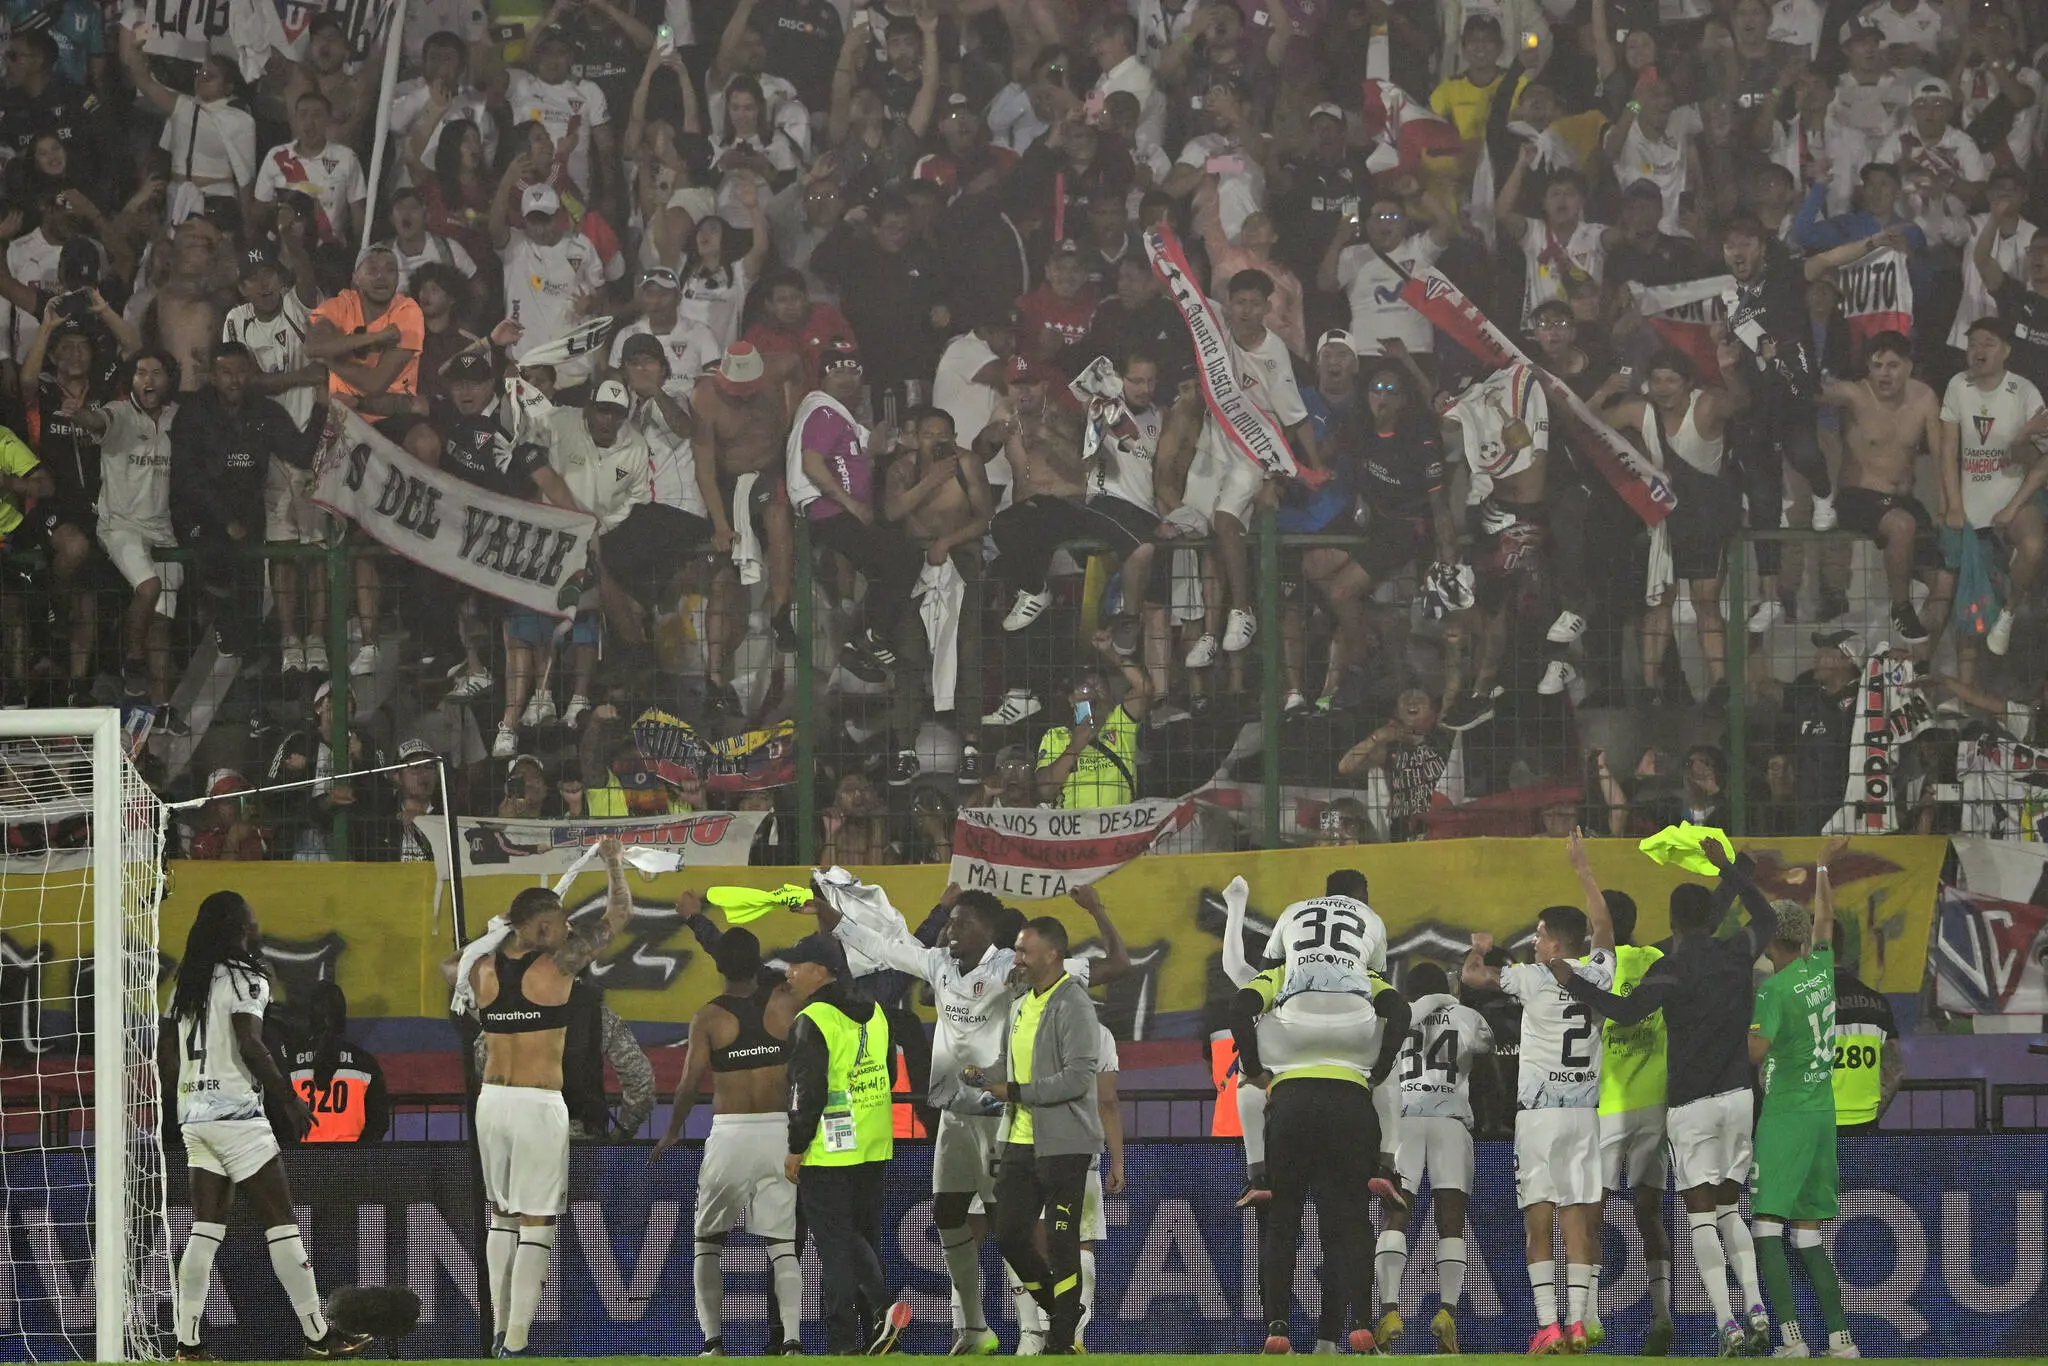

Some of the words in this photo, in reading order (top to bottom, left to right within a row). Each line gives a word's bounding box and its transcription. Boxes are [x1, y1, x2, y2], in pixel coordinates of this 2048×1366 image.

[376, 464, 443, 540] DEL
[459, 505, 578, 586] VALLE
[1003, 814, 1038, 836] VOS
[1050, 814, 1081, 837] QUE
[1099, 807, 1157, 834] DESDE
[967, 863, 1068, 897] MALETA
[1292, 907, 1367, 959] 32
[1298, 954, 1355, 970] DISCOVER
[487, 1010, 541, 1021] marathon
[186, 1013, 207, 1075] 4
[728, 1045, 781, 1059] marathon
[1560, 1004, 1592, 1067] 2
[1399, 1028, 1459, 1085] 34
[1834, 1045, 1877, 1069] 280
[300, 1079, 348, 1114] 320
